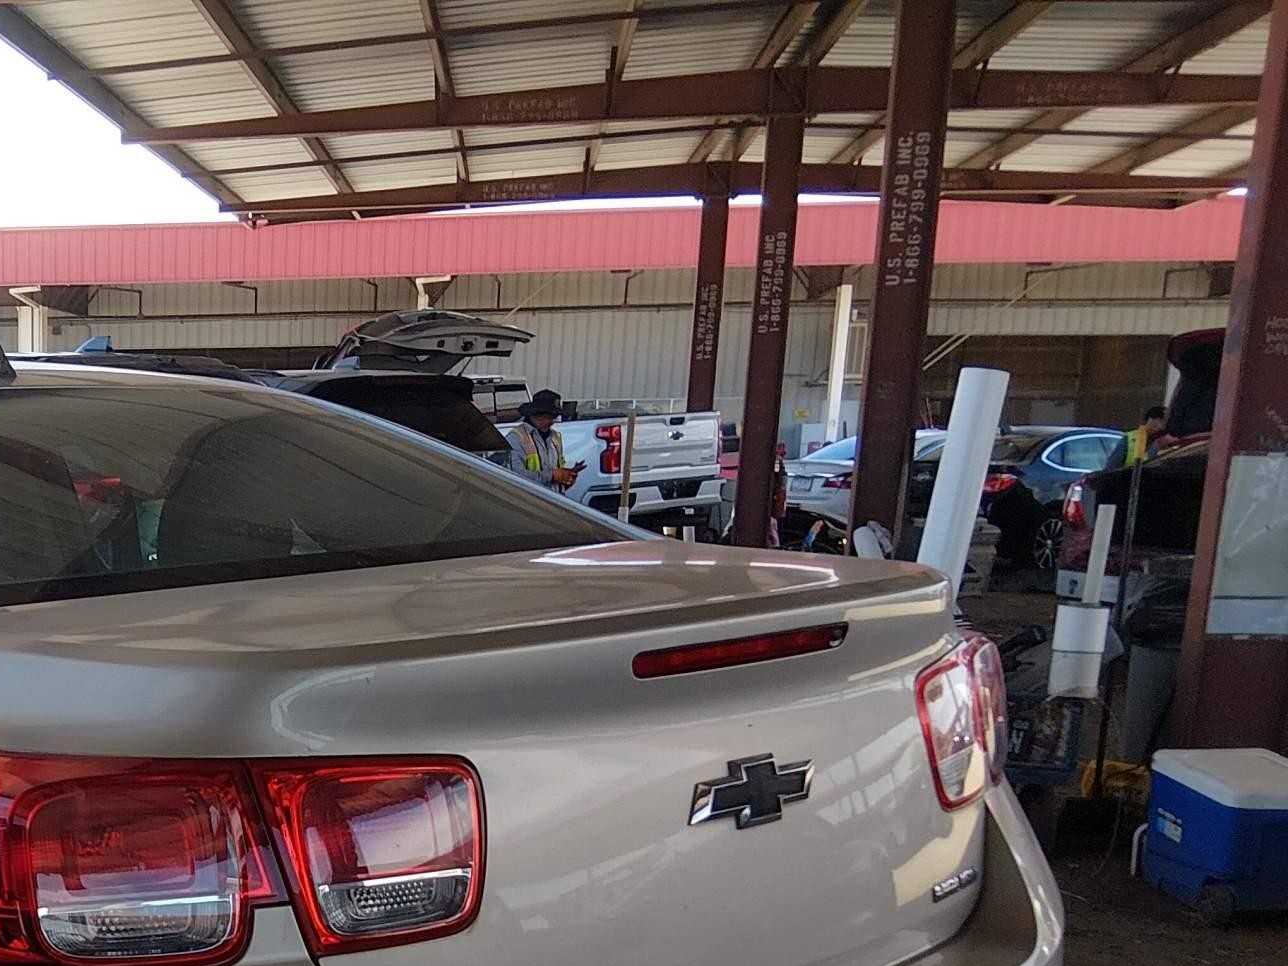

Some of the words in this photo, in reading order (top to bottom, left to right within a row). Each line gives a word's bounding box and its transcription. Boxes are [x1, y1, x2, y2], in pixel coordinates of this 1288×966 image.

[897, 131, 914, 166] INC.
[889, 173, 911, 242] PREFAB
[904, 131, 931, 284] 1-866-799-0969
[760, 259, 774, 306] PREFAB
[885, 253, 904, 285] U.S.
